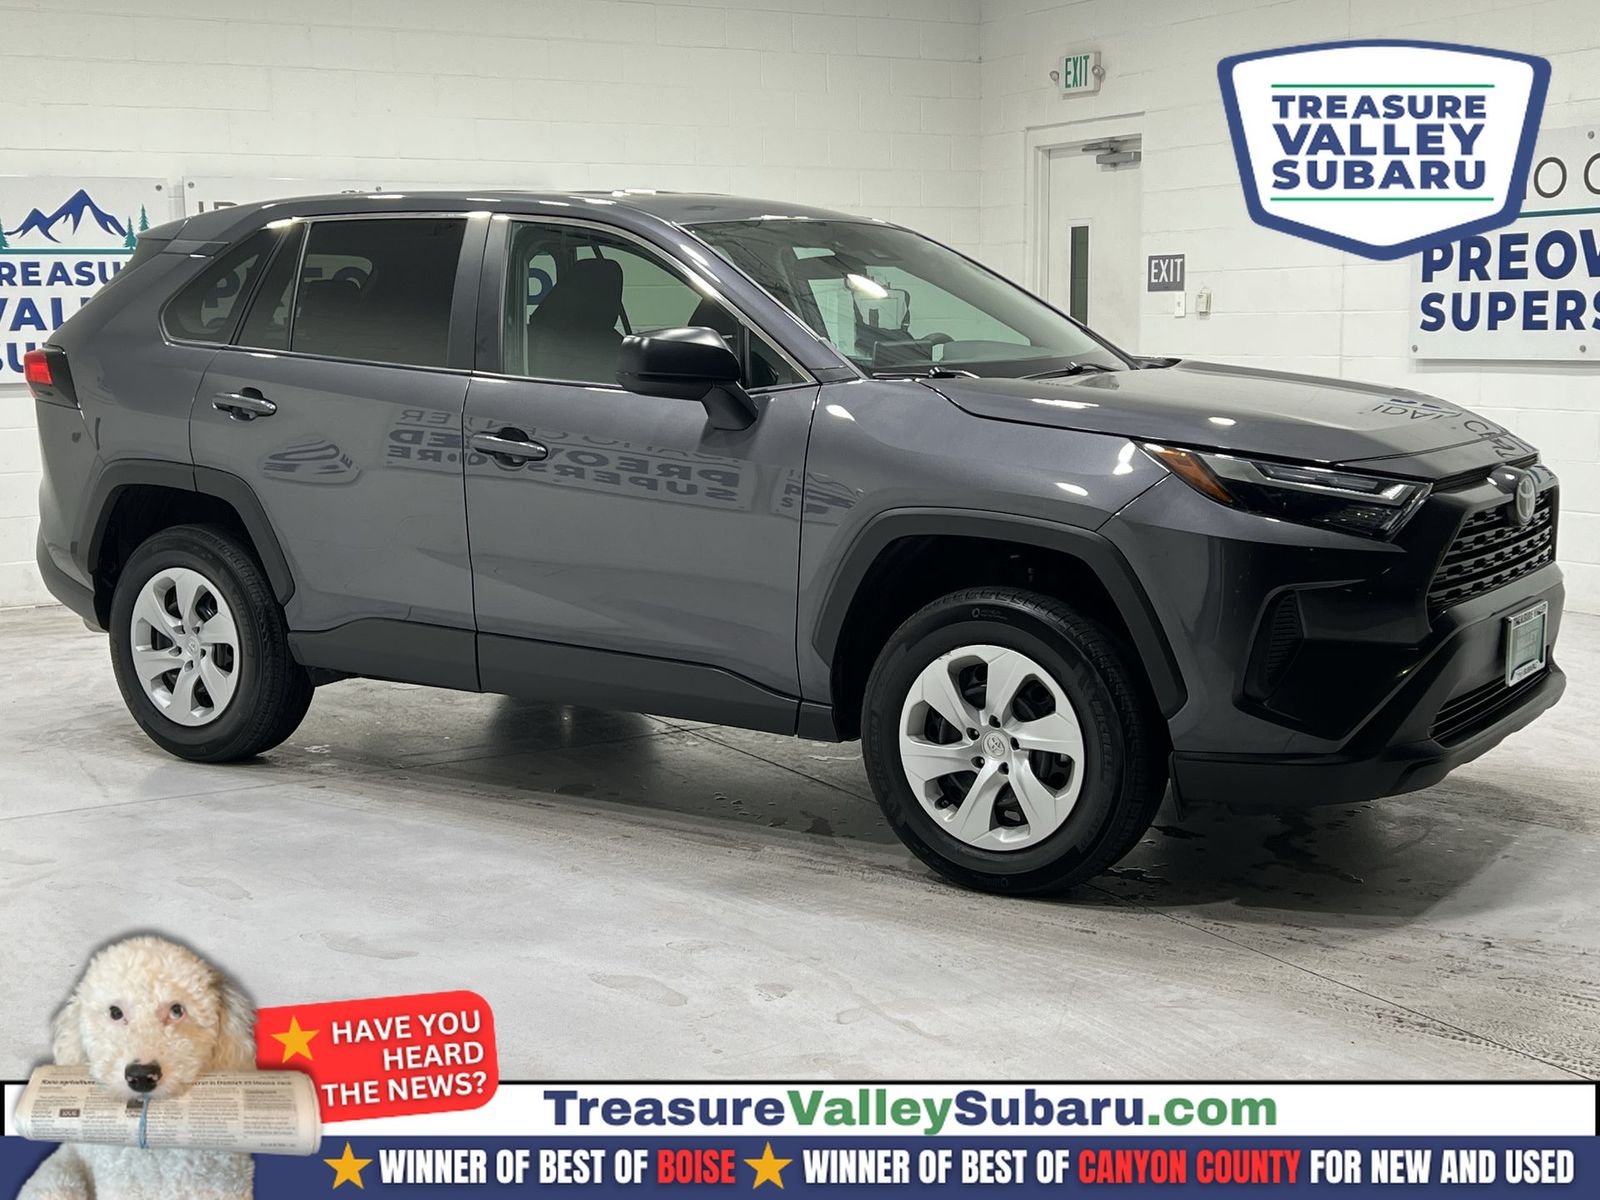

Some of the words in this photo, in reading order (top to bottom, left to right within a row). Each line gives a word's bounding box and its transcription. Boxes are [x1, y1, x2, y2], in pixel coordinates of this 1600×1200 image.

[1065, 55, 1090, 88] EXIT
[1151, 258, 1184, 283] EXIT
[1419, 289, 1600, 332] SUPER
